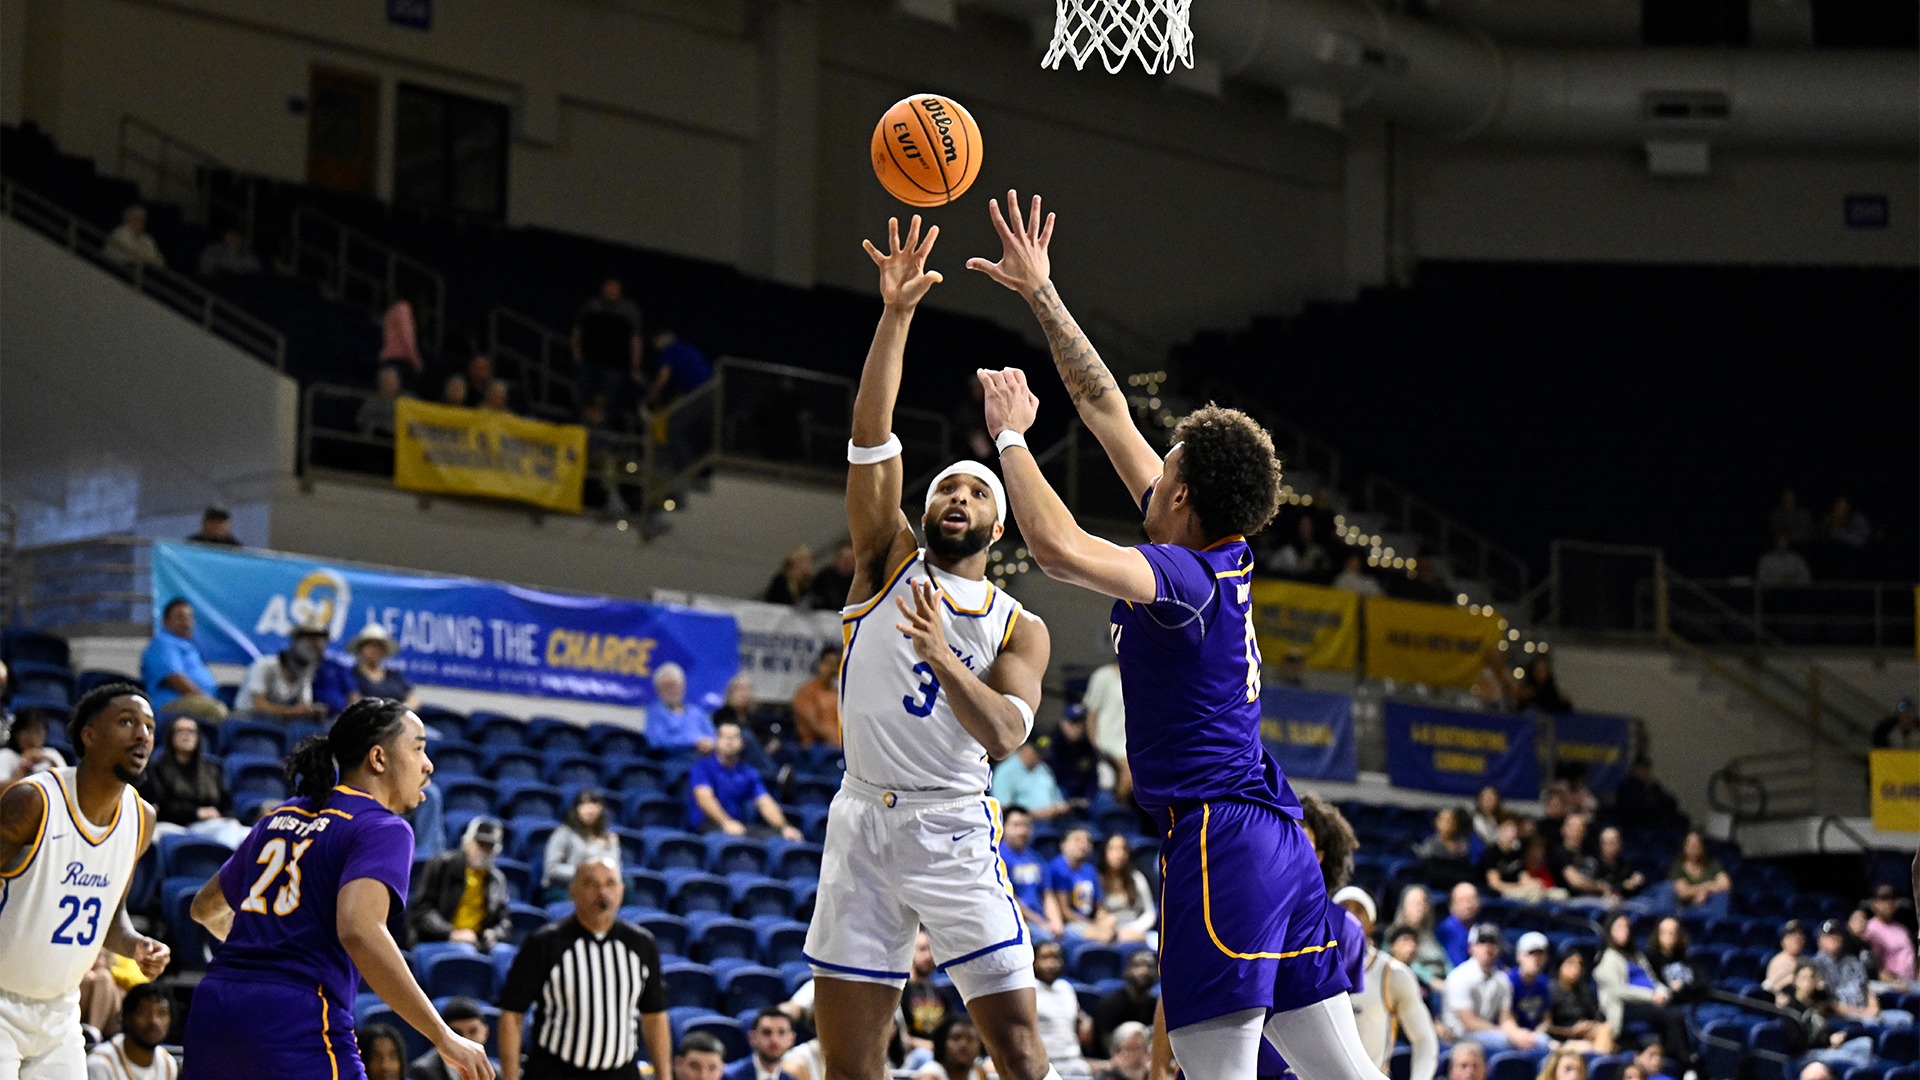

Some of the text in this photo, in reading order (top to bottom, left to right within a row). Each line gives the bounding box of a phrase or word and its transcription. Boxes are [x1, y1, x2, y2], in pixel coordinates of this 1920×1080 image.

[893, 122, 920, 159] EVO
[921, 98, 957, 162] Wilson
[489, 618, 541, 667] THE
[546, 627, 657, 677] CHARGE
[903, 661, 940, 718] 3
[268, 815, 330, 837] MUSTS
[60, 861, 109, 888] Rams
[50, 894, 102, 946] 23
